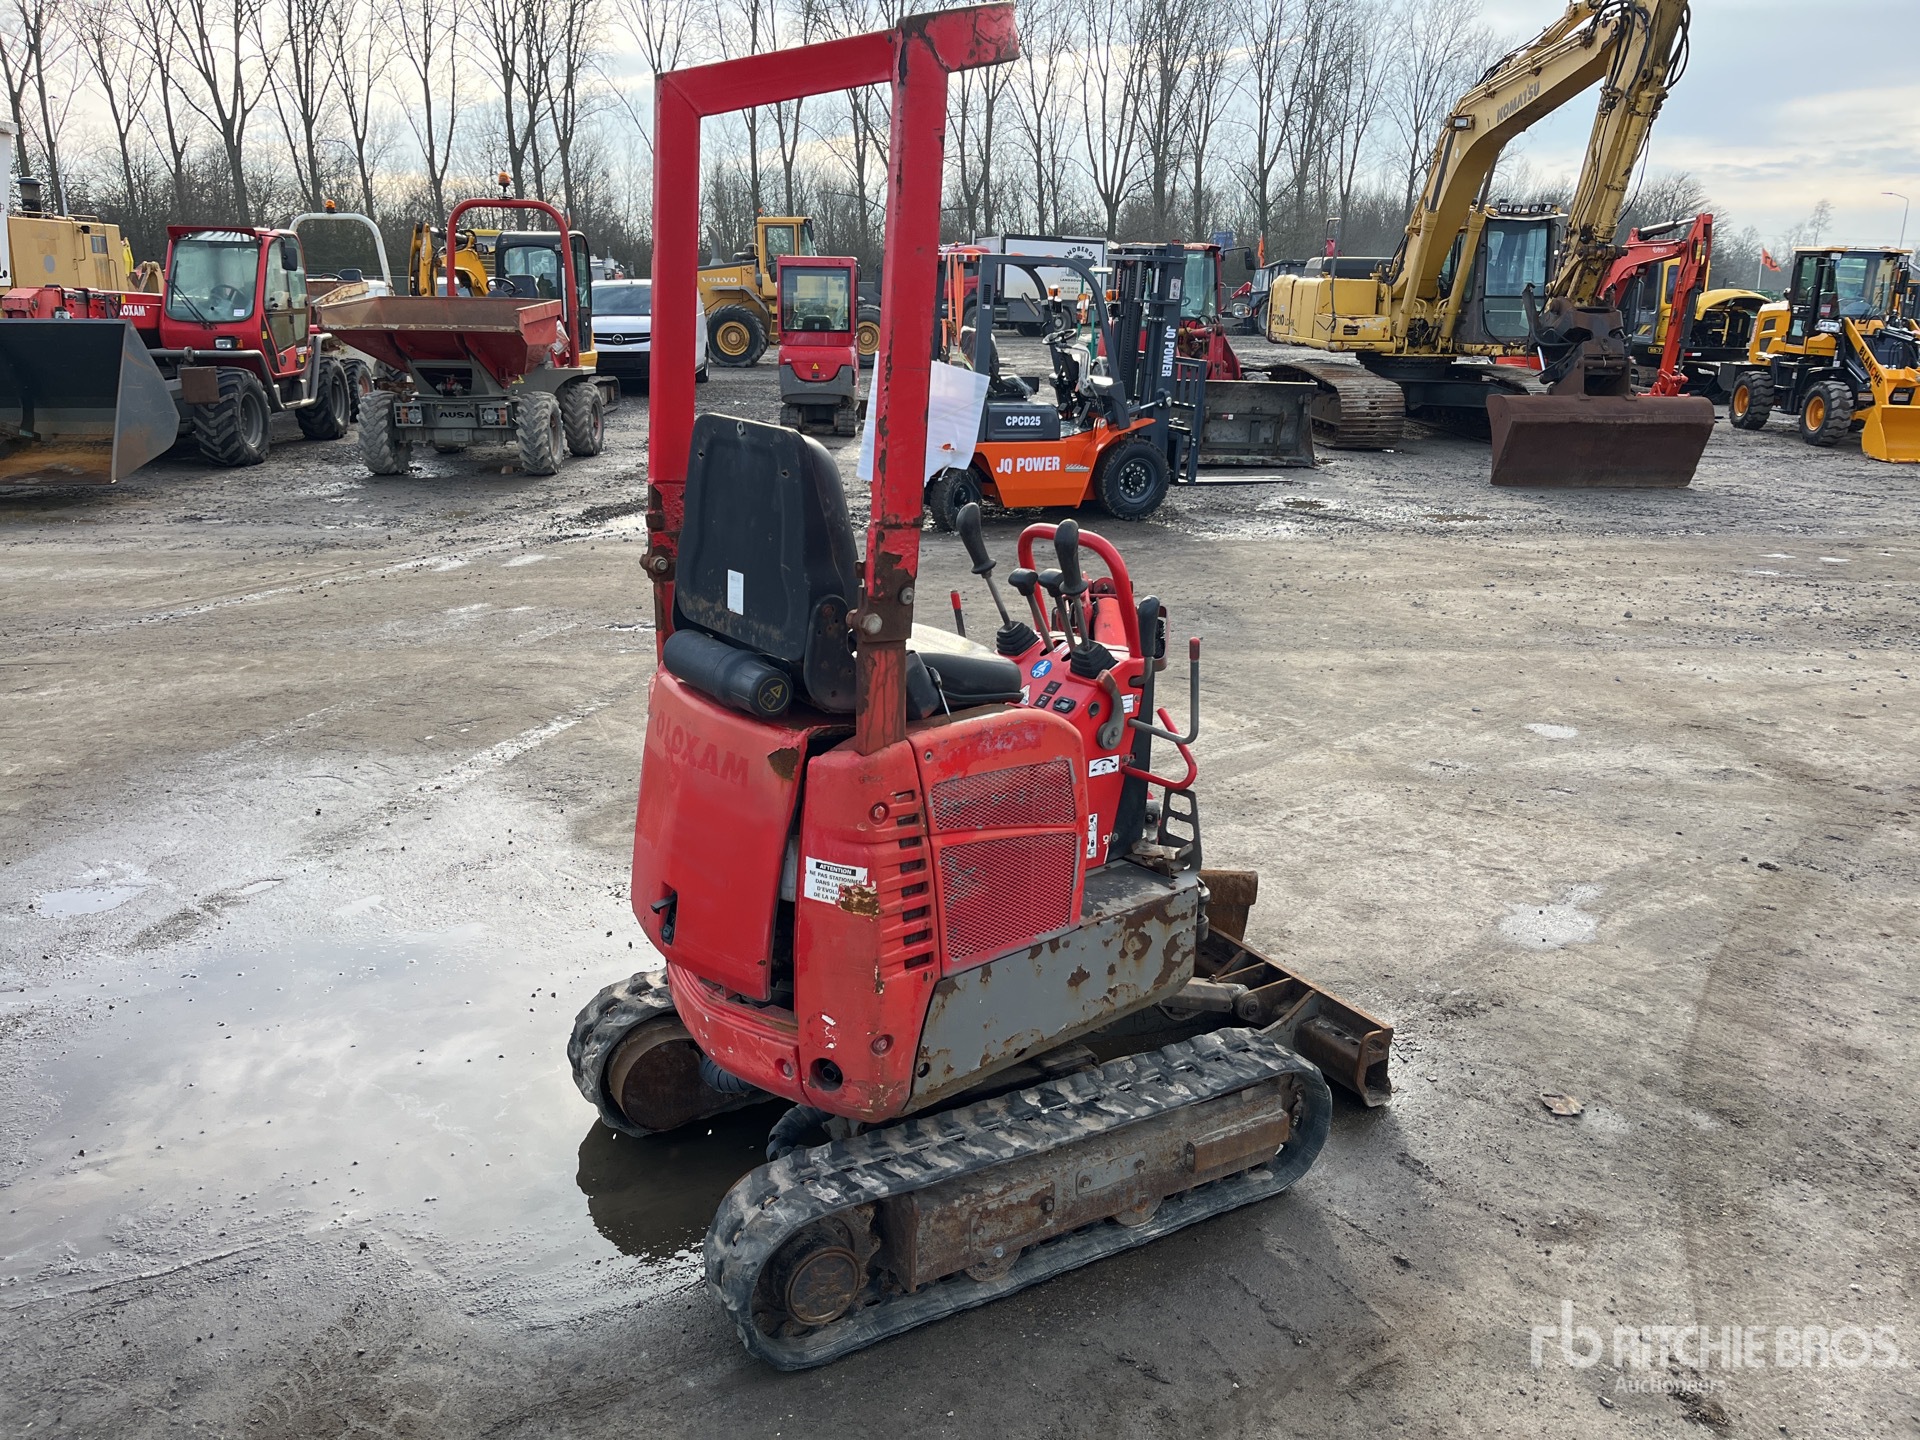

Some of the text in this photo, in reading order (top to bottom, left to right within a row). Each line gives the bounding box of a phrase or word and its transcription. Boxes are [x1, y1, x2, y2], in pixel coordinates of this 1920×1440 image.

[1497, 81, 1540, 123] KOMATSU
[120, 305, 146, 316] LOXAM
[1161, 325, 1176, 377] JQ POWER
[1859, 346, 1883, 388] BLANCHE
[1005, 416, 1041, 426] CPCD25
[996, 456, 1060, 474] JQ POWER
[817, 871, 828, 879] PAS
[819, 864, 852, 875] ATTENTION
[815, 878, 830, 886] DANS
[821, 892, 829, 900] LA
